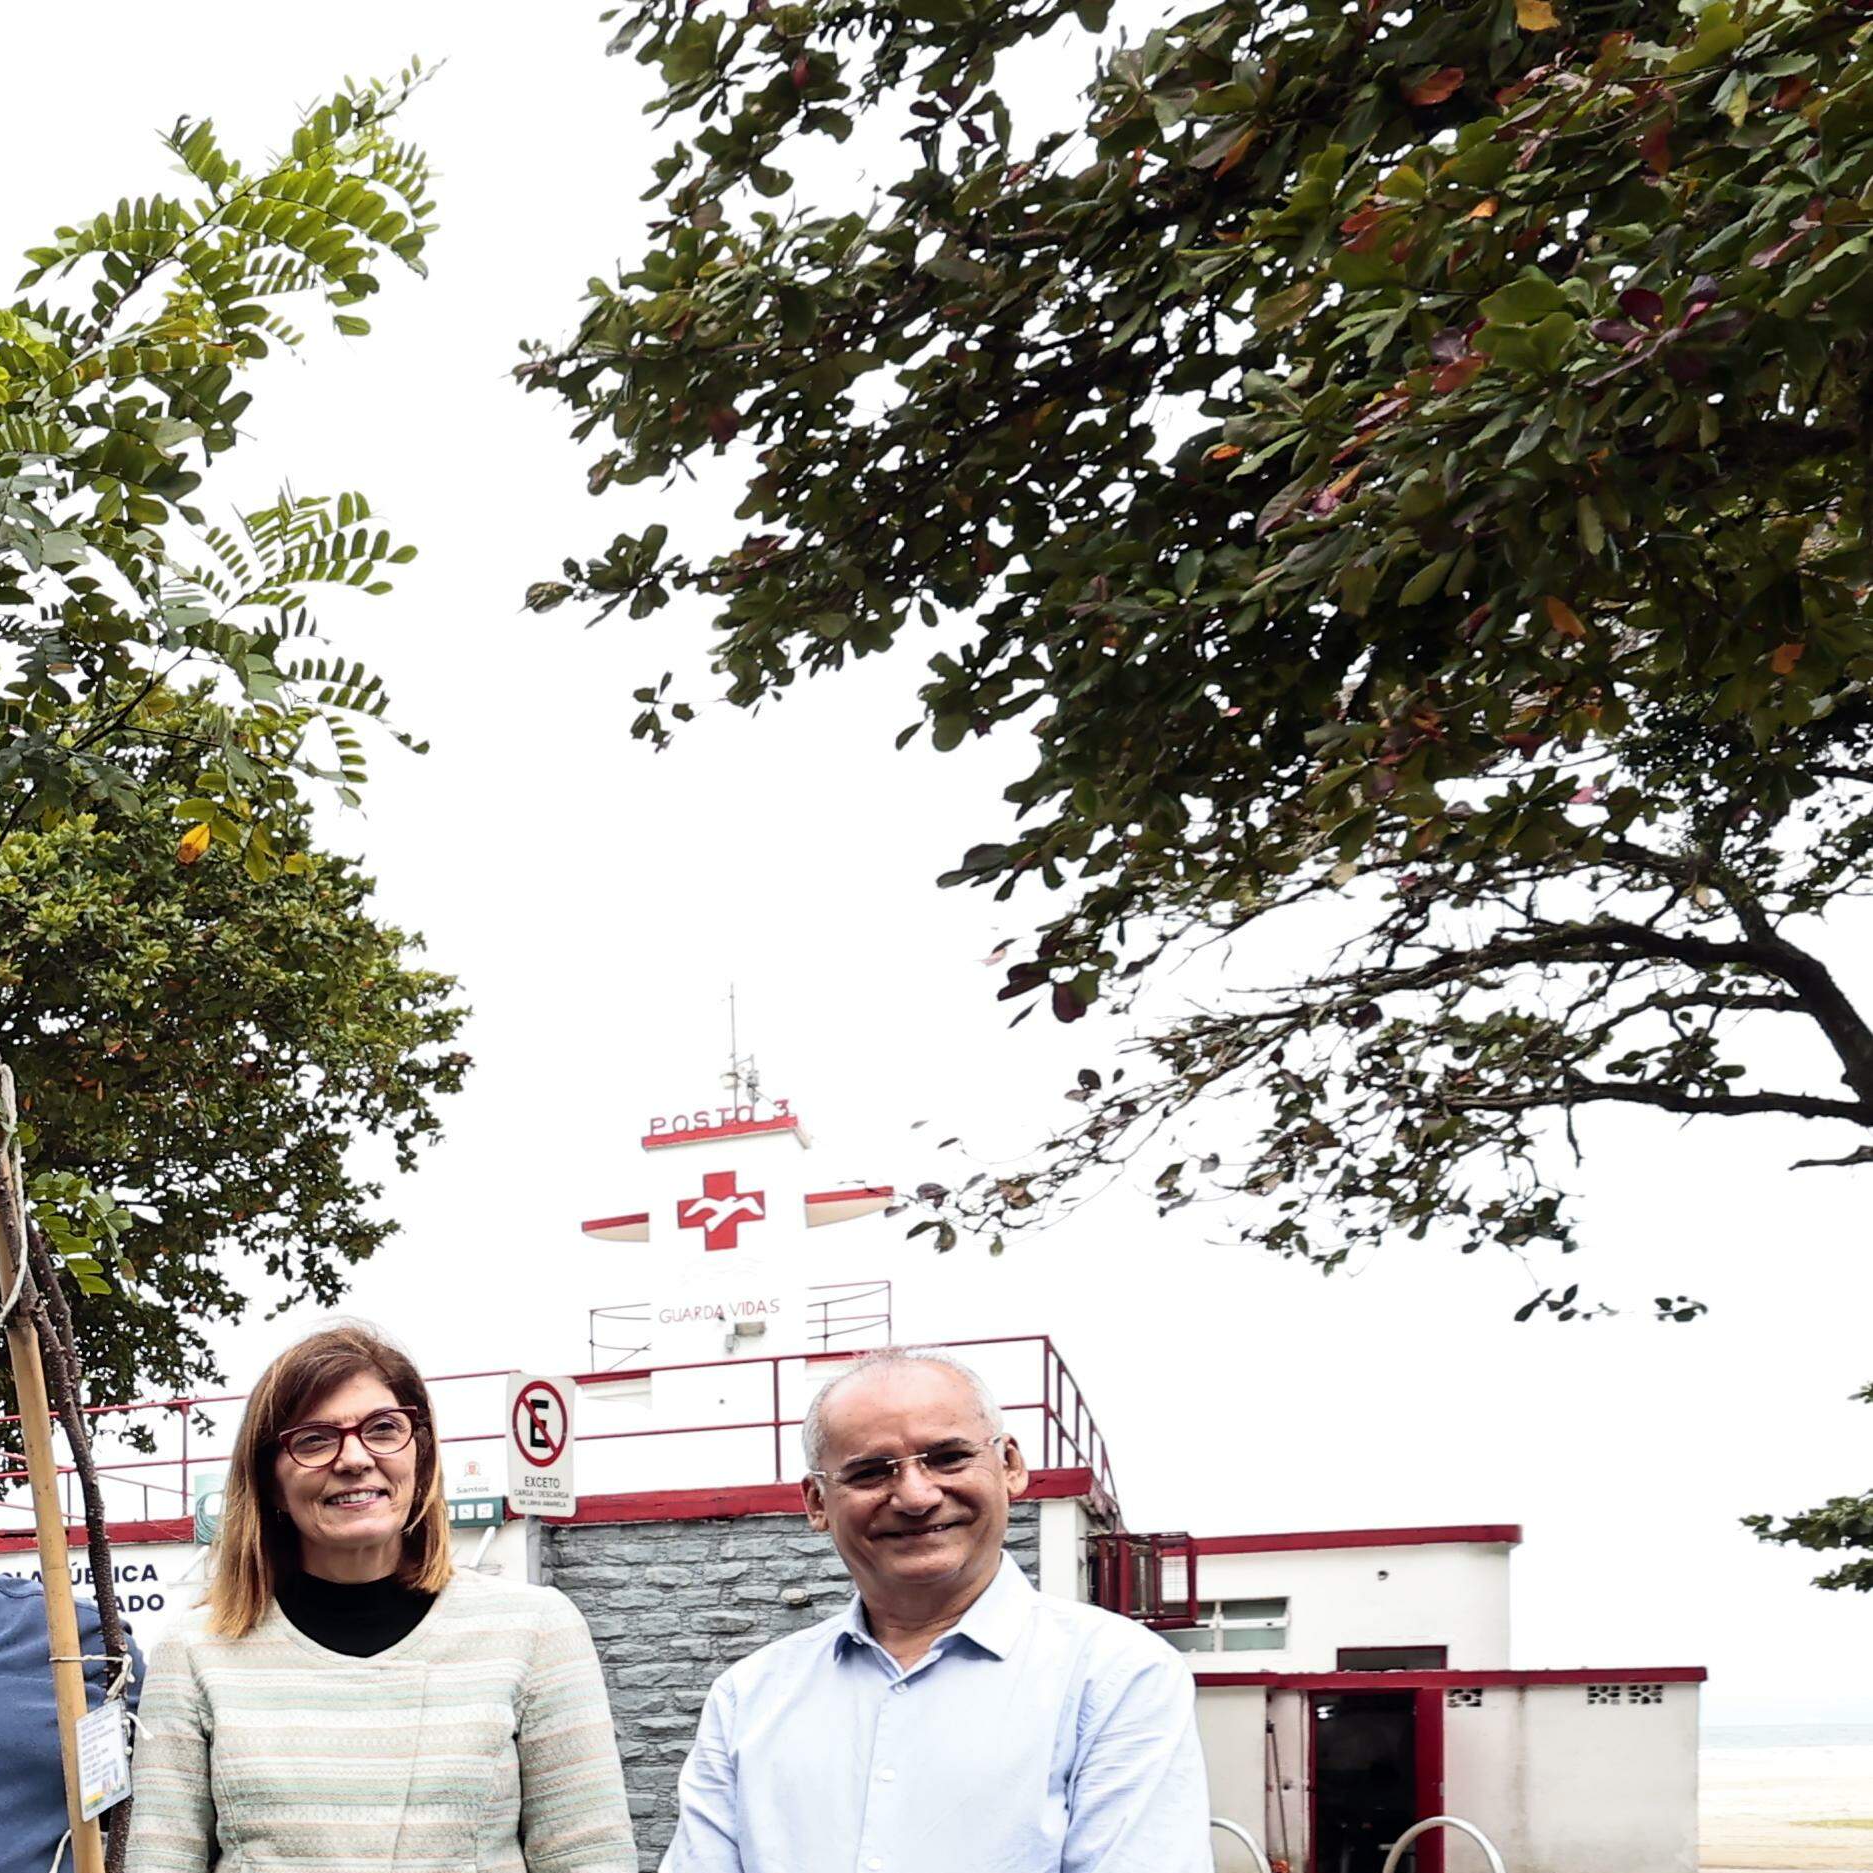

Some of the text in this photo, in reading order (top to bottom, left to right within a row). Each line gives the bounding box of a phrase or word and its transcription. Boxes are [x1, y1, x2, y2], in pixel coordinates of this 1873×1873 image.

[650, 1099, 789, 1135] POSTO 3
[660, 1299, 780, 1324] GUARDA VIDAS
[524, 1476, 560, 1489] EXCETO
[456, 1485, 489, 1494] Santos
[514, 1489, 533, 1497] CARGA
[538, 1490, 569, 1499] DESCARGA
